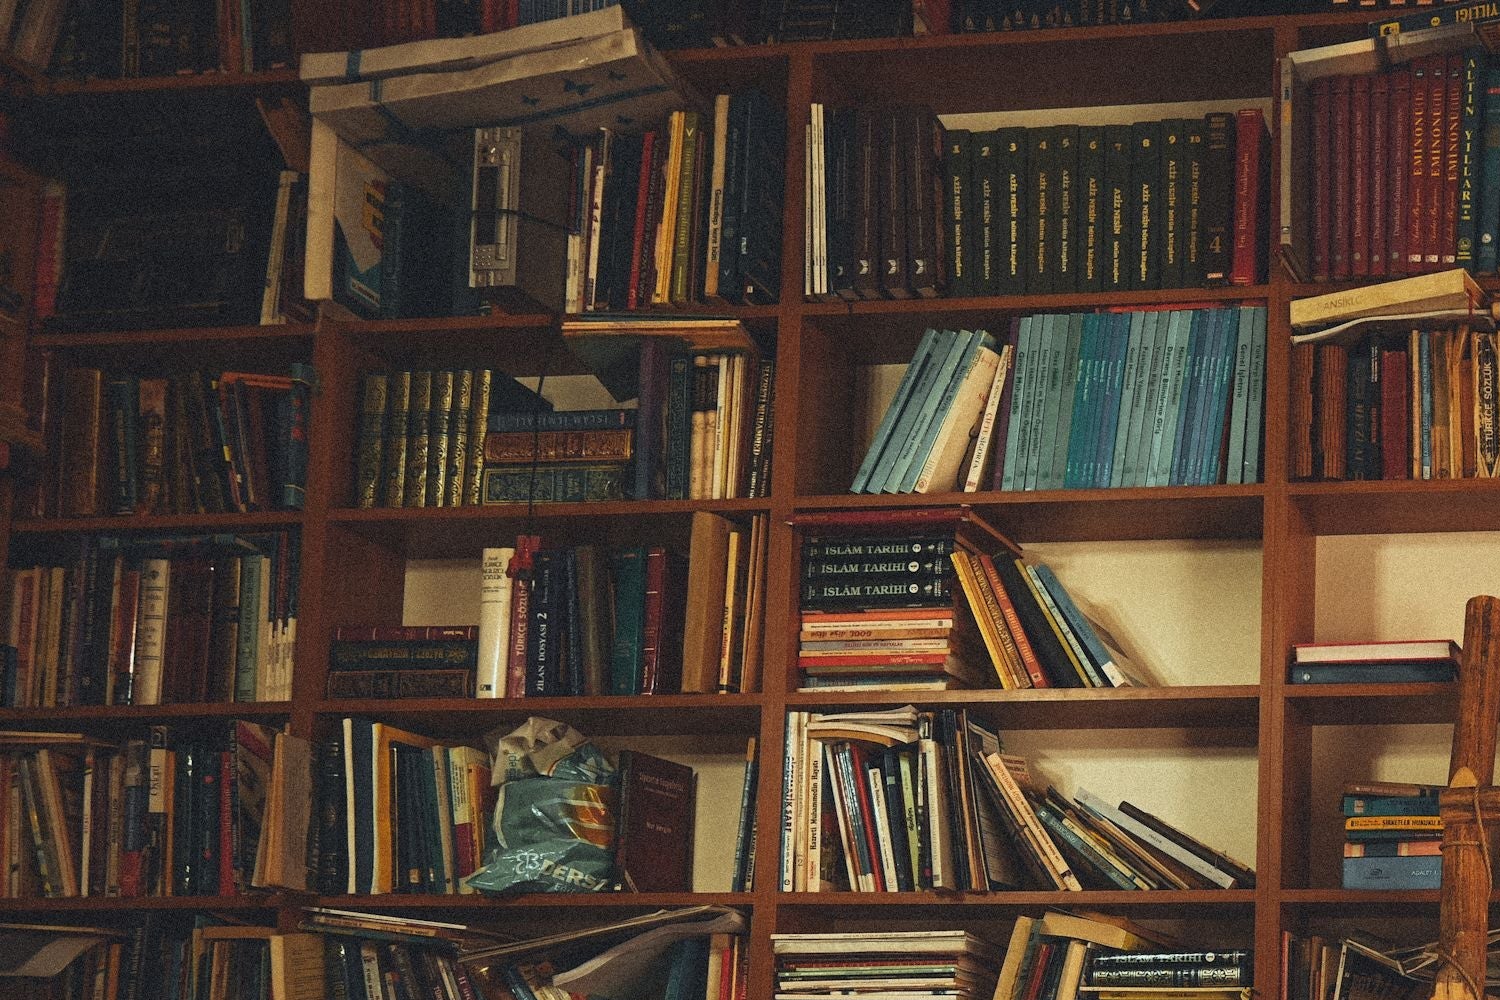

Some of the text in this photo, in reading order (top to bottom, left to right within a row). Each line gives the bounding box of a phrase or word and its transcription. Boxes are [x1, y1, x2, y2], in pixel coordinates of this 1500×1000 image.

[1465, 58, 1476, 116] ALTIN
[1209, 234, 1222, 254] 4
[824, 543, 909, 556] İSLÂM TARİHİ
[821, 561, 906, 574] İSLÂM TARİHİ
[823, 583, 908, 597] İSLÂM TARİHİ
[536, 611, 548, 692] ZİLAN DOSYASI 2
